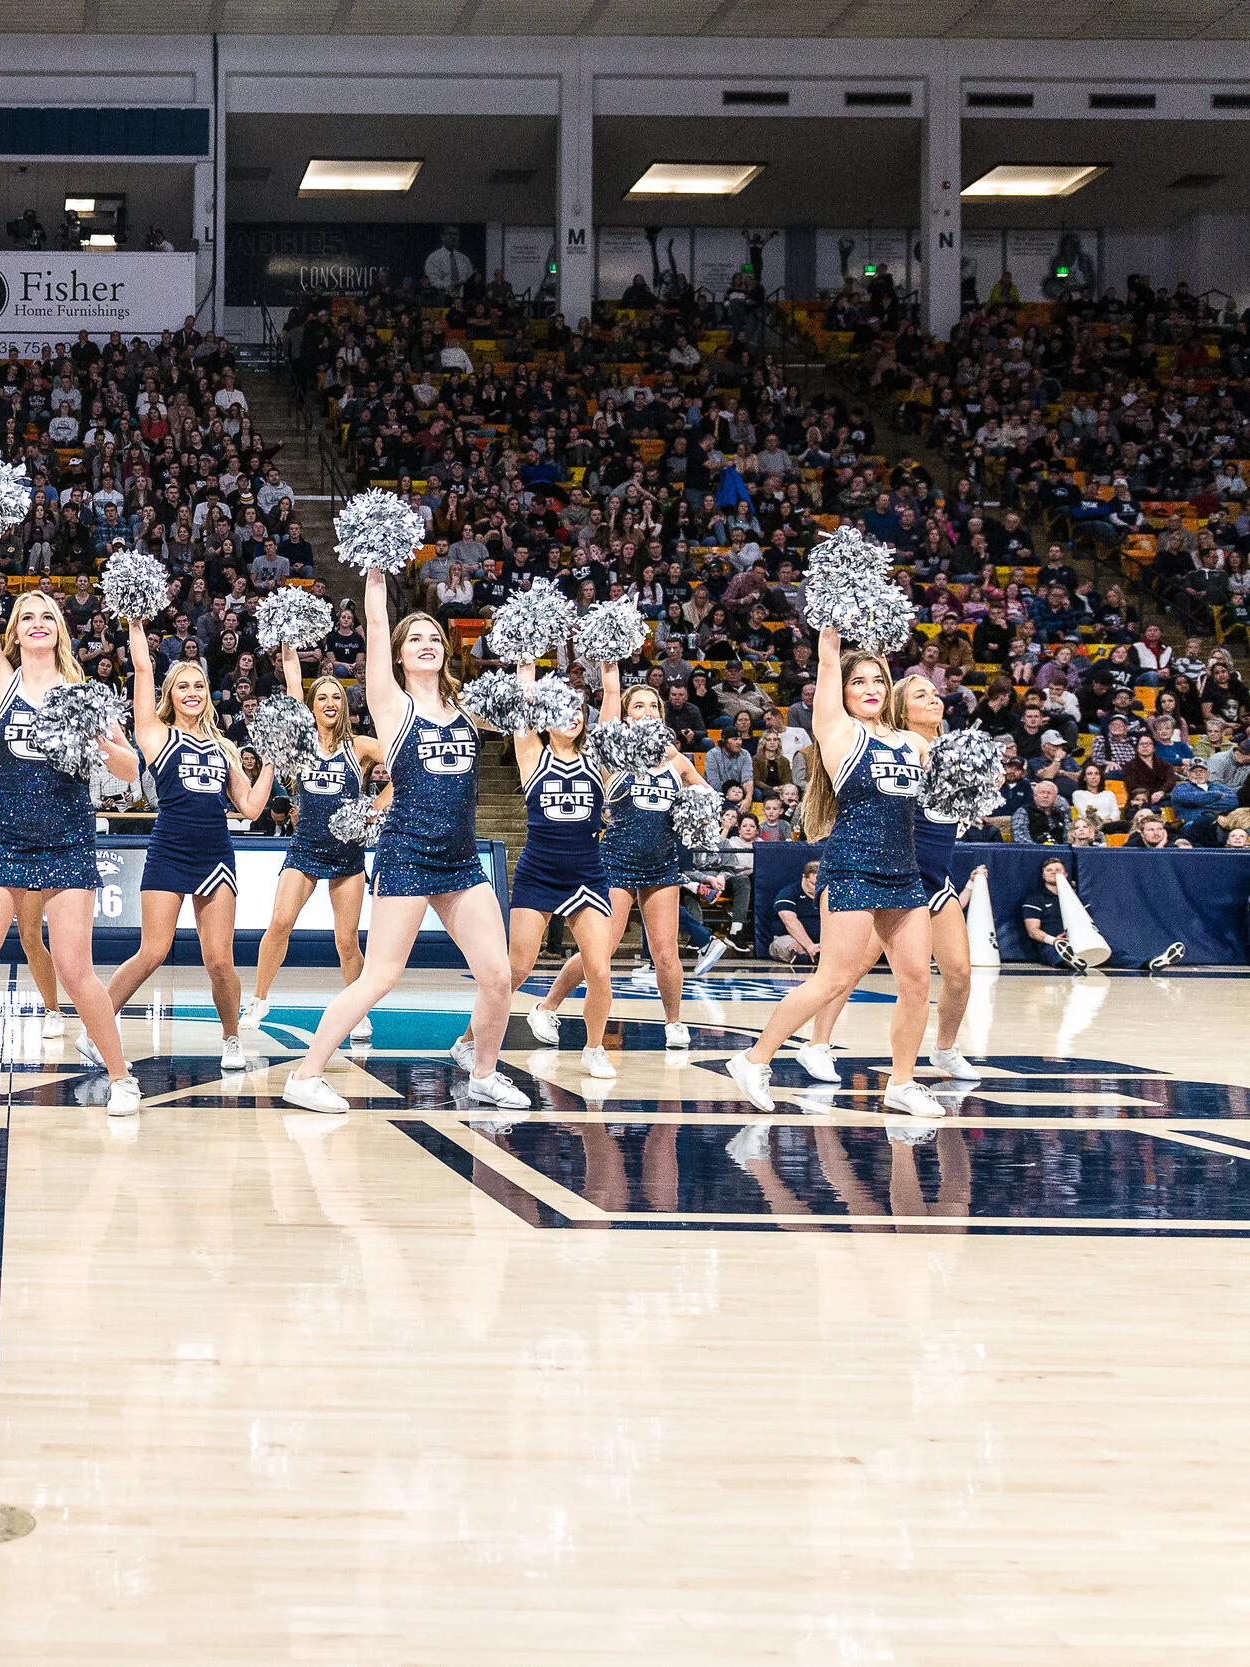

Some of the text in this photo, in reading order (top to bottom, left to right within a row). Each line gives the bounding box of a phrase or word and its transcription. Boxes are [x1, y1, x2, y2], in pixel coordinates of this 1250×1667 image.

[205, 226, 214, 242] L
[568, 228, 585, 245] M
[939, 232, 953, 249] N
[19, 269, 125, 302] Fisher
[14, 304, 130, 320] Home Furnishings
[5, 724, 38, 741] STA
[418, 742, 476, 760] STATE
[178, 765, 226, 783] STATE
[540, 793, 594, 807] STATE
[630, 785, 675, 800] STATE
[95, 850, 125, 865] VADA
